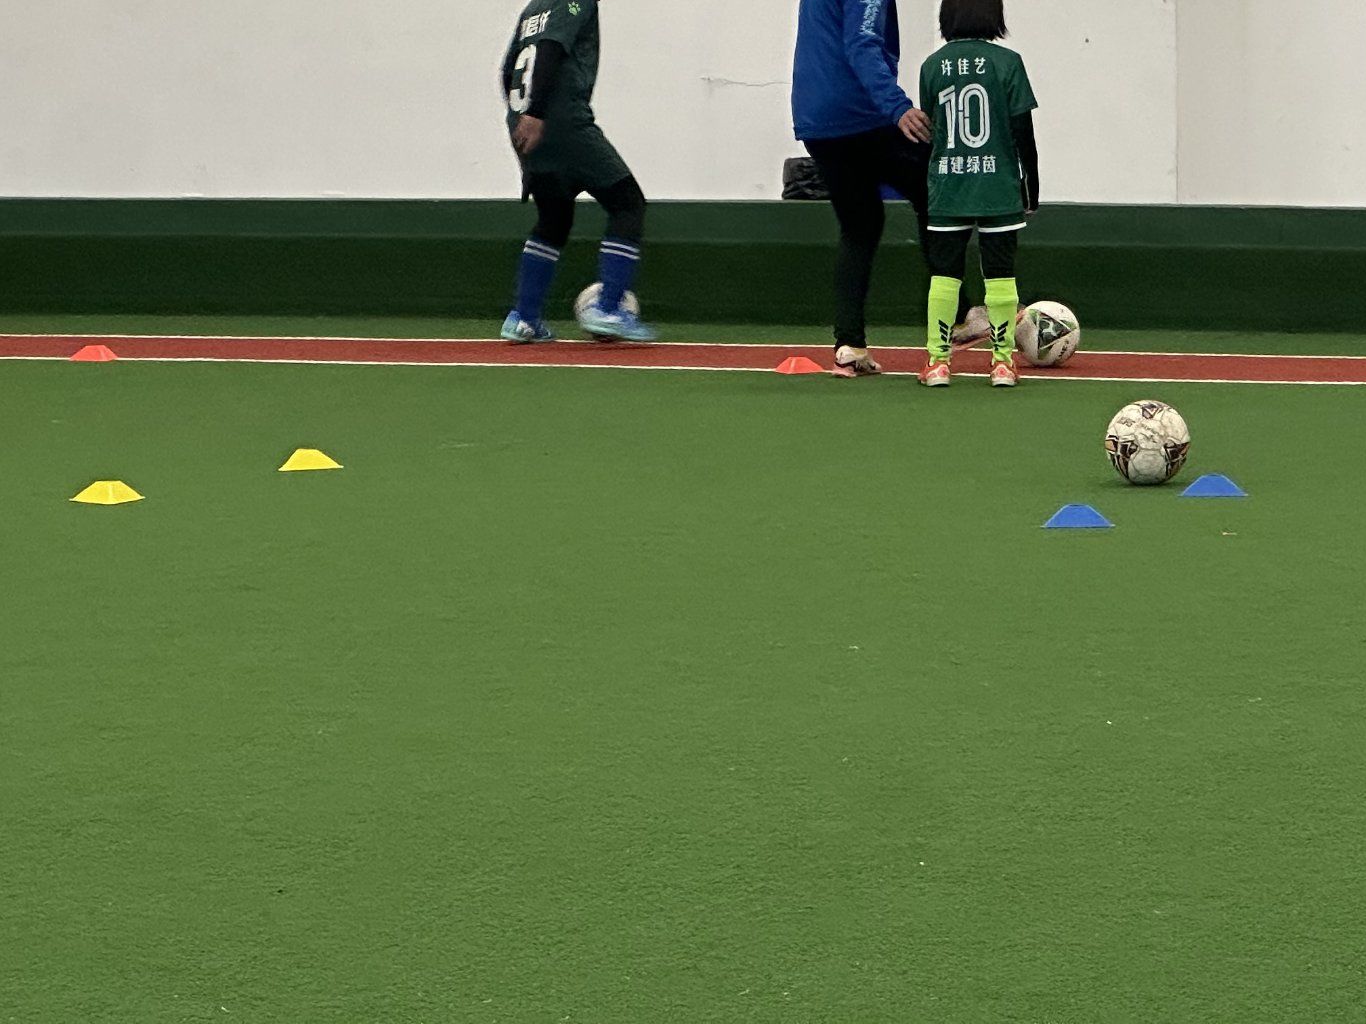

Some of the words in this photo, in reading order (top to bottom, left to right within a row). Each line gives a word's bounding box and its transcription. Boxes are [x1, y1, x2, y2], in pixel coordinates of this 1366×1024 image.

[509, 43, 537, 114] 3
[941, 57, 986, 76] 许佳艺
[938, 83, 991, 149] 10
[938, 155, 996, 175] 福建绿茵
